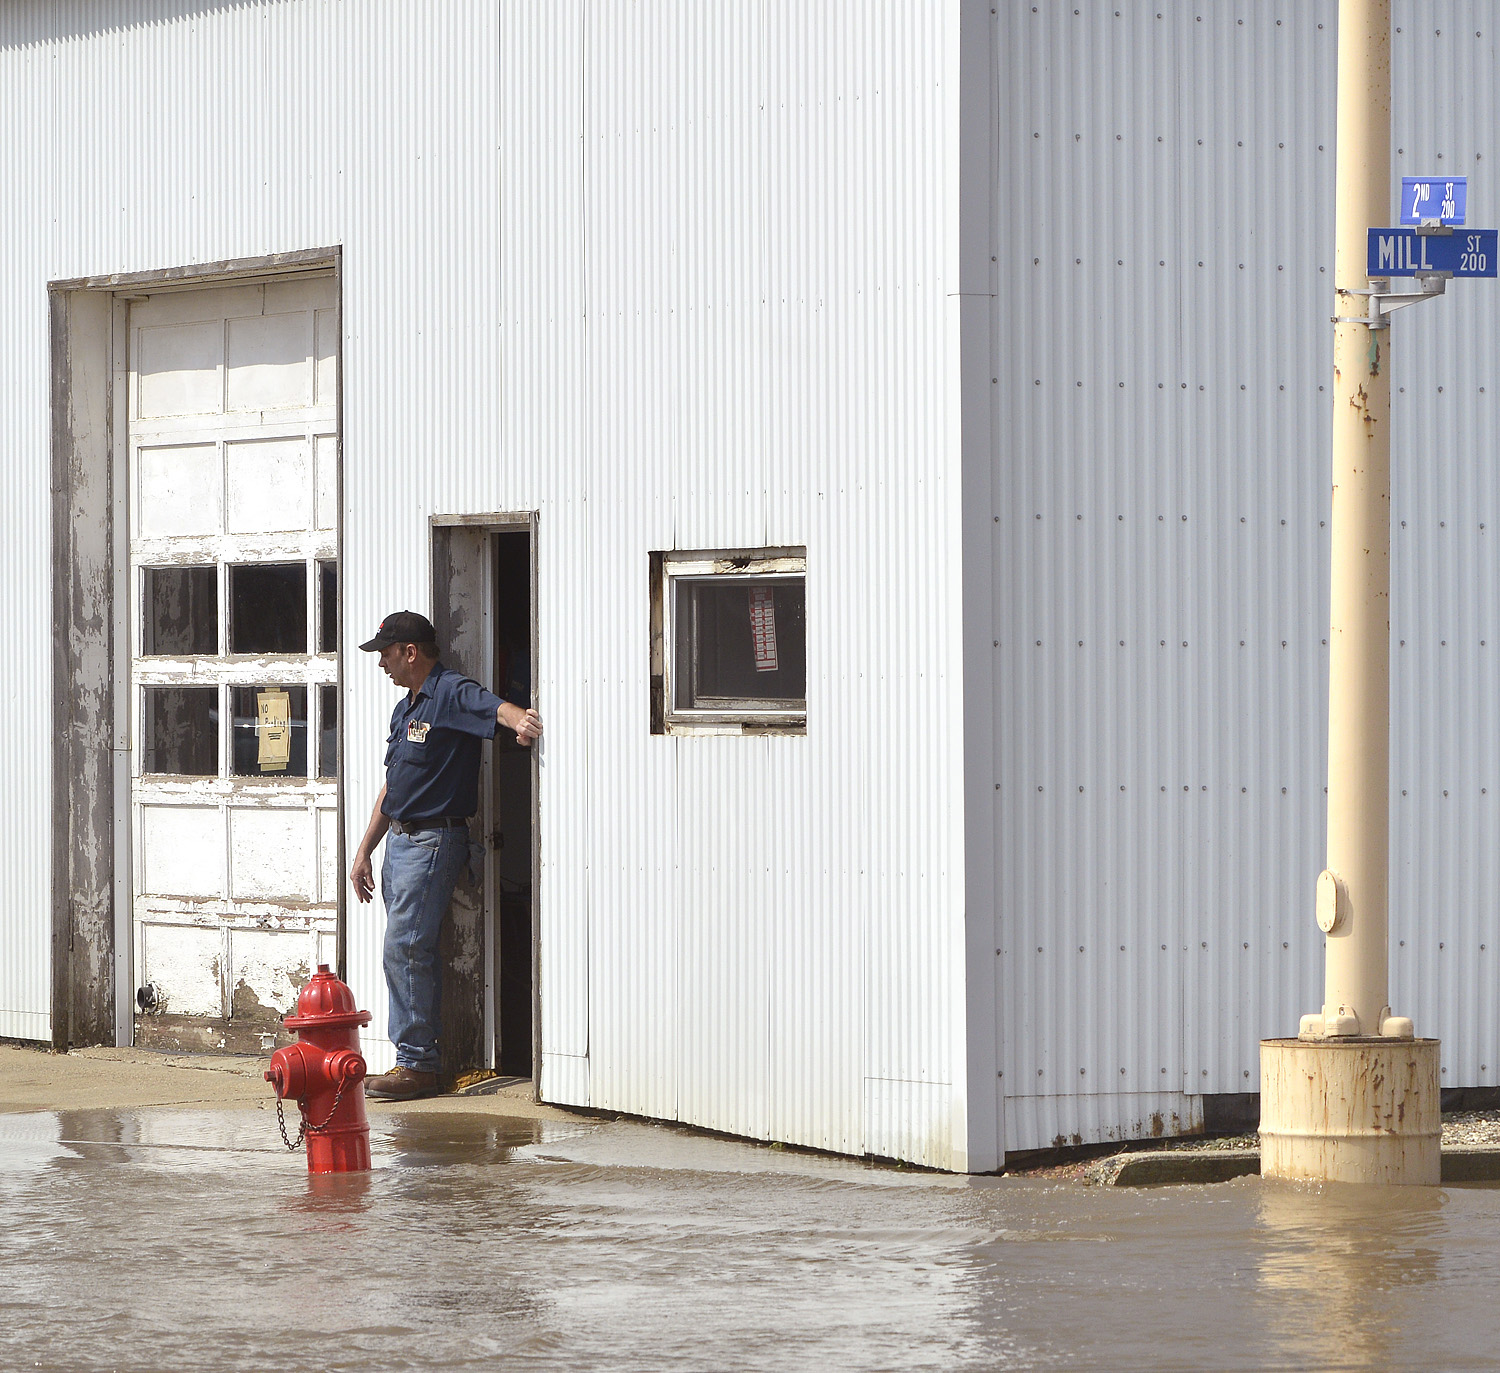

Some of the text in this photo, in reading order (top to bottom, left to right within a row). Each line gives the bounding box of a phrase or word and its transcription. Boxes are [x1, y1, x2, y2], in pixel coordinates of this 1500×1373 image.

[1411, 182, 1454, 218] 2ND ST
[1441, 200, 1455, 219] 200
[1378, 235, 1481, 270] MILL ST
[1460, 253, 1487, 271] 200
